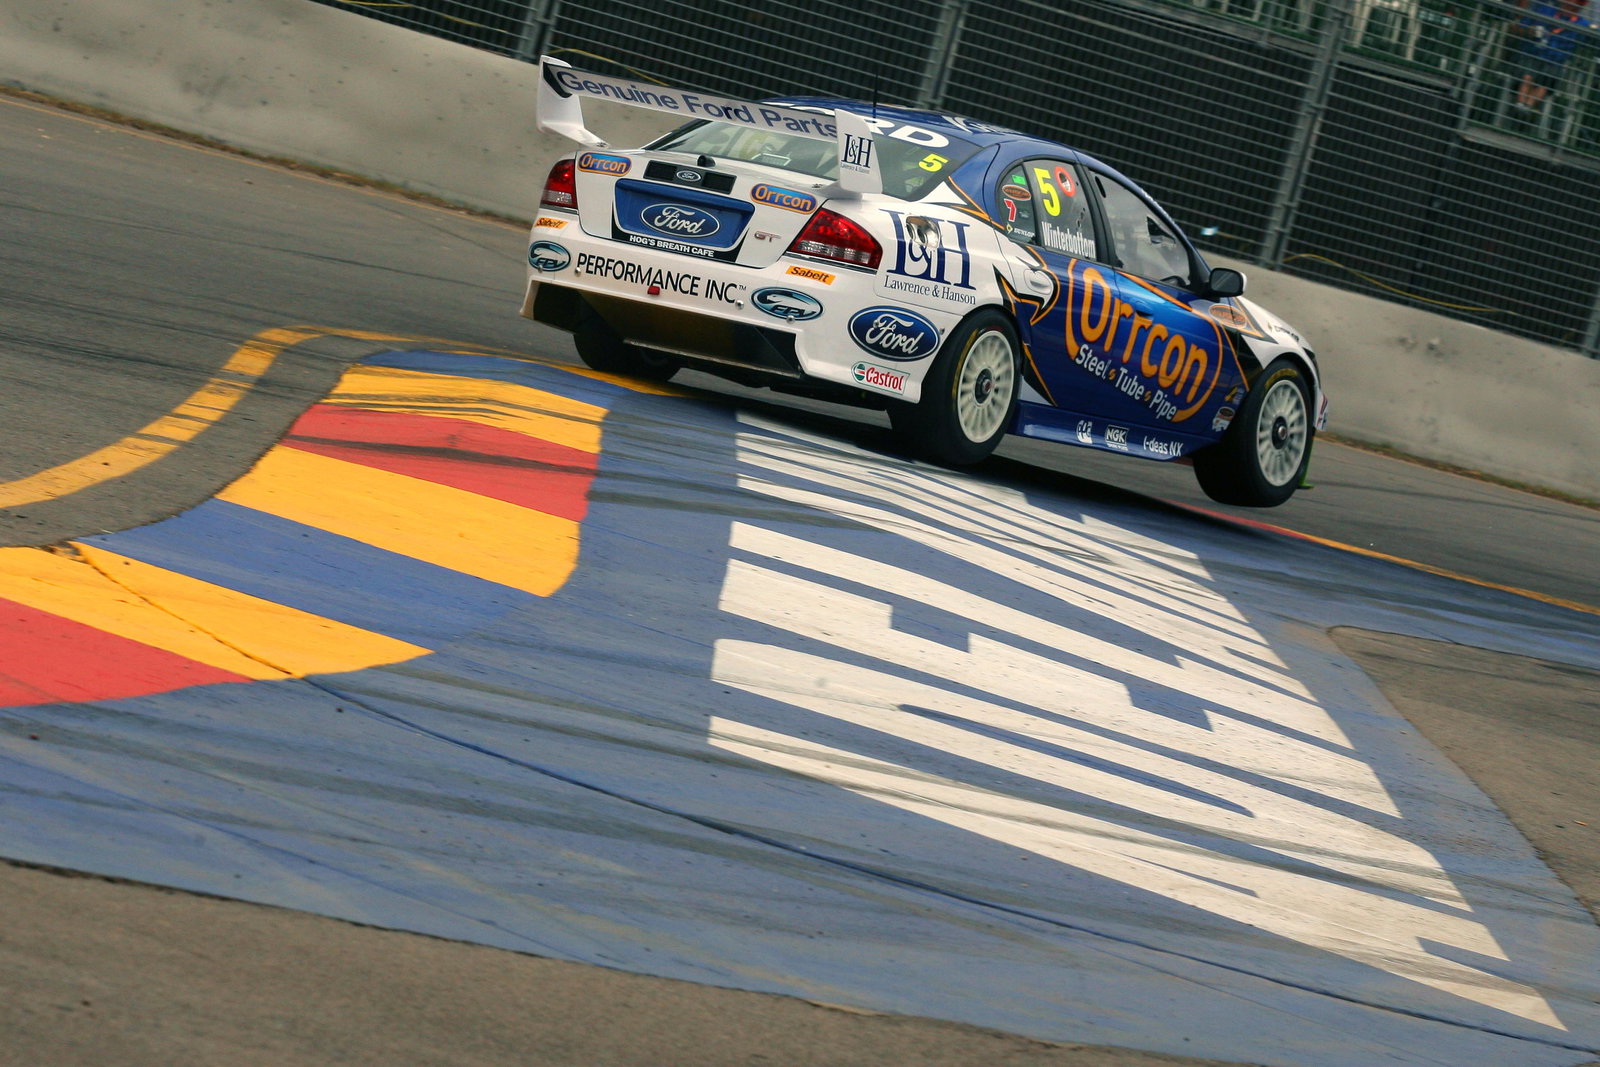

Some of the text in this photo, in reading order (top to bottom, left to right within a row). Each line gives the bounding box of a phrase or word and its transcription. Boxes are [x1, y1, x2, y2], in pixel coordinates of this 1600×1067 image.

[556, 71, 838, 138] Genuine Ford Parts
[581, 154, 627, 173] Orrcon
[841, 133, 874, 168] L&H
[918, 153, 949, 172] 5
[755, 186, 813, 213] Orrcon
[1034, 168, 1061, 217] 5
[654, 206, 706, 235] Ford
[629, 235, 715, 258] HOG'S BREATH CAFE
[754, 230, 781, 243] GT
[1041, 221, 1097, 259] Winterbottom
[577, 252, 700, 296] PERFORMANCE
[790, 266, 829, 284] Sabelt
[883, 275, 977, 305] Lawrence & Hanson
[865, 313, 925, 355] Ford
[1080, 267, 1209, 403] Orrcon
[865, 367, 905, 392] Castrol
[1075, 343, 1178, 421] Steel Tube Pipe
[1106, 428, 1127, 443] NGK
[707, 410, 1565, 1032] ADELAIDE
